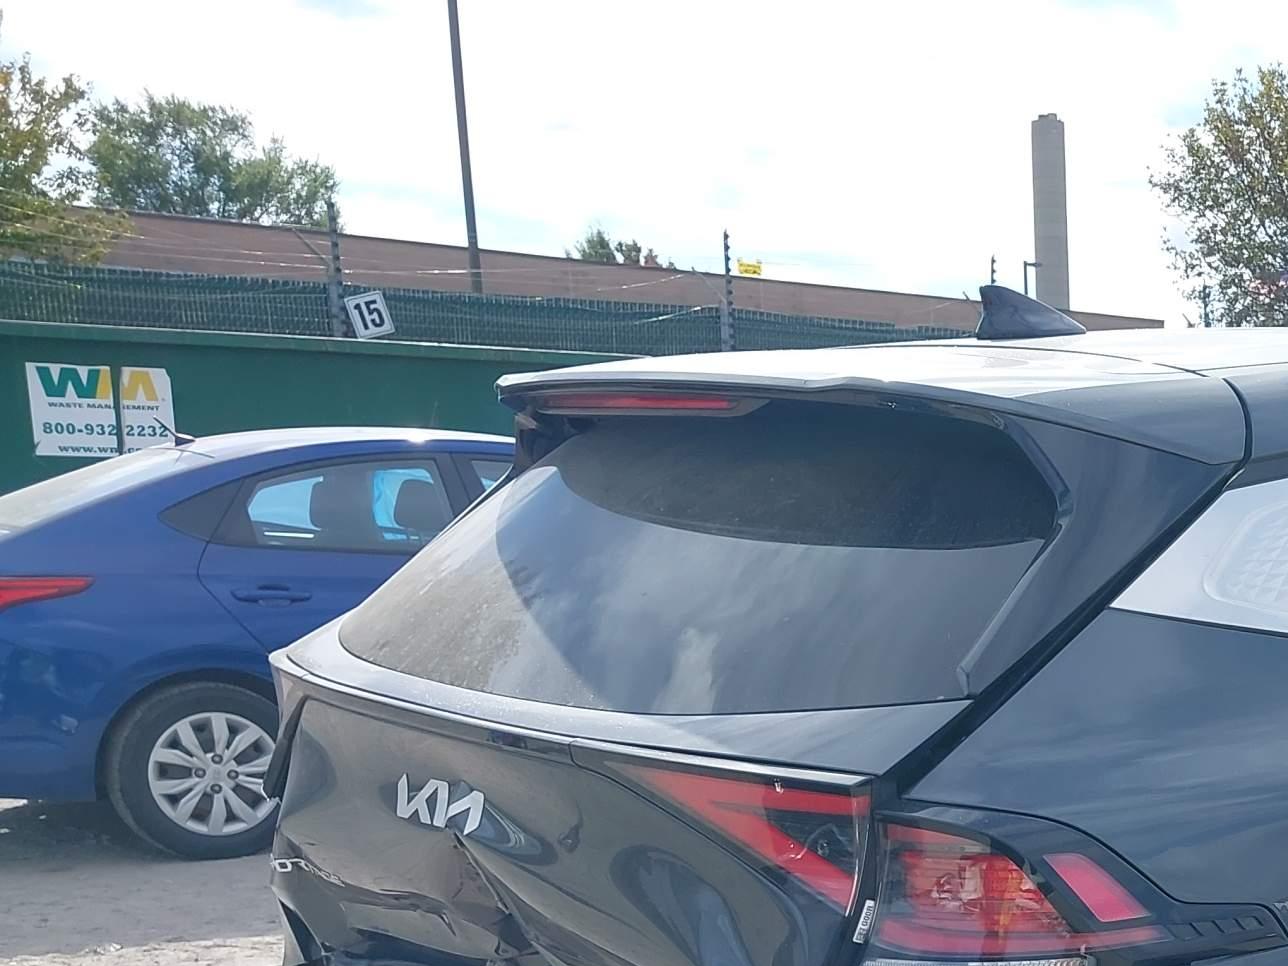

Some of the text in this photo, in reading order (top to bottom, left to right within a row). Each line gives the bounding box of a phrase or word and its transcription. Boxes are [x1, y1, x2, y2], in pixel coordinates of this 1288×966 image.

[353, 299, 386, 331] 15
[47, 402, 160, 411] WASTE MANEMENT
[42, 421, 169, 438] 800-9322232
[396, 773, 485, 836] KIA
